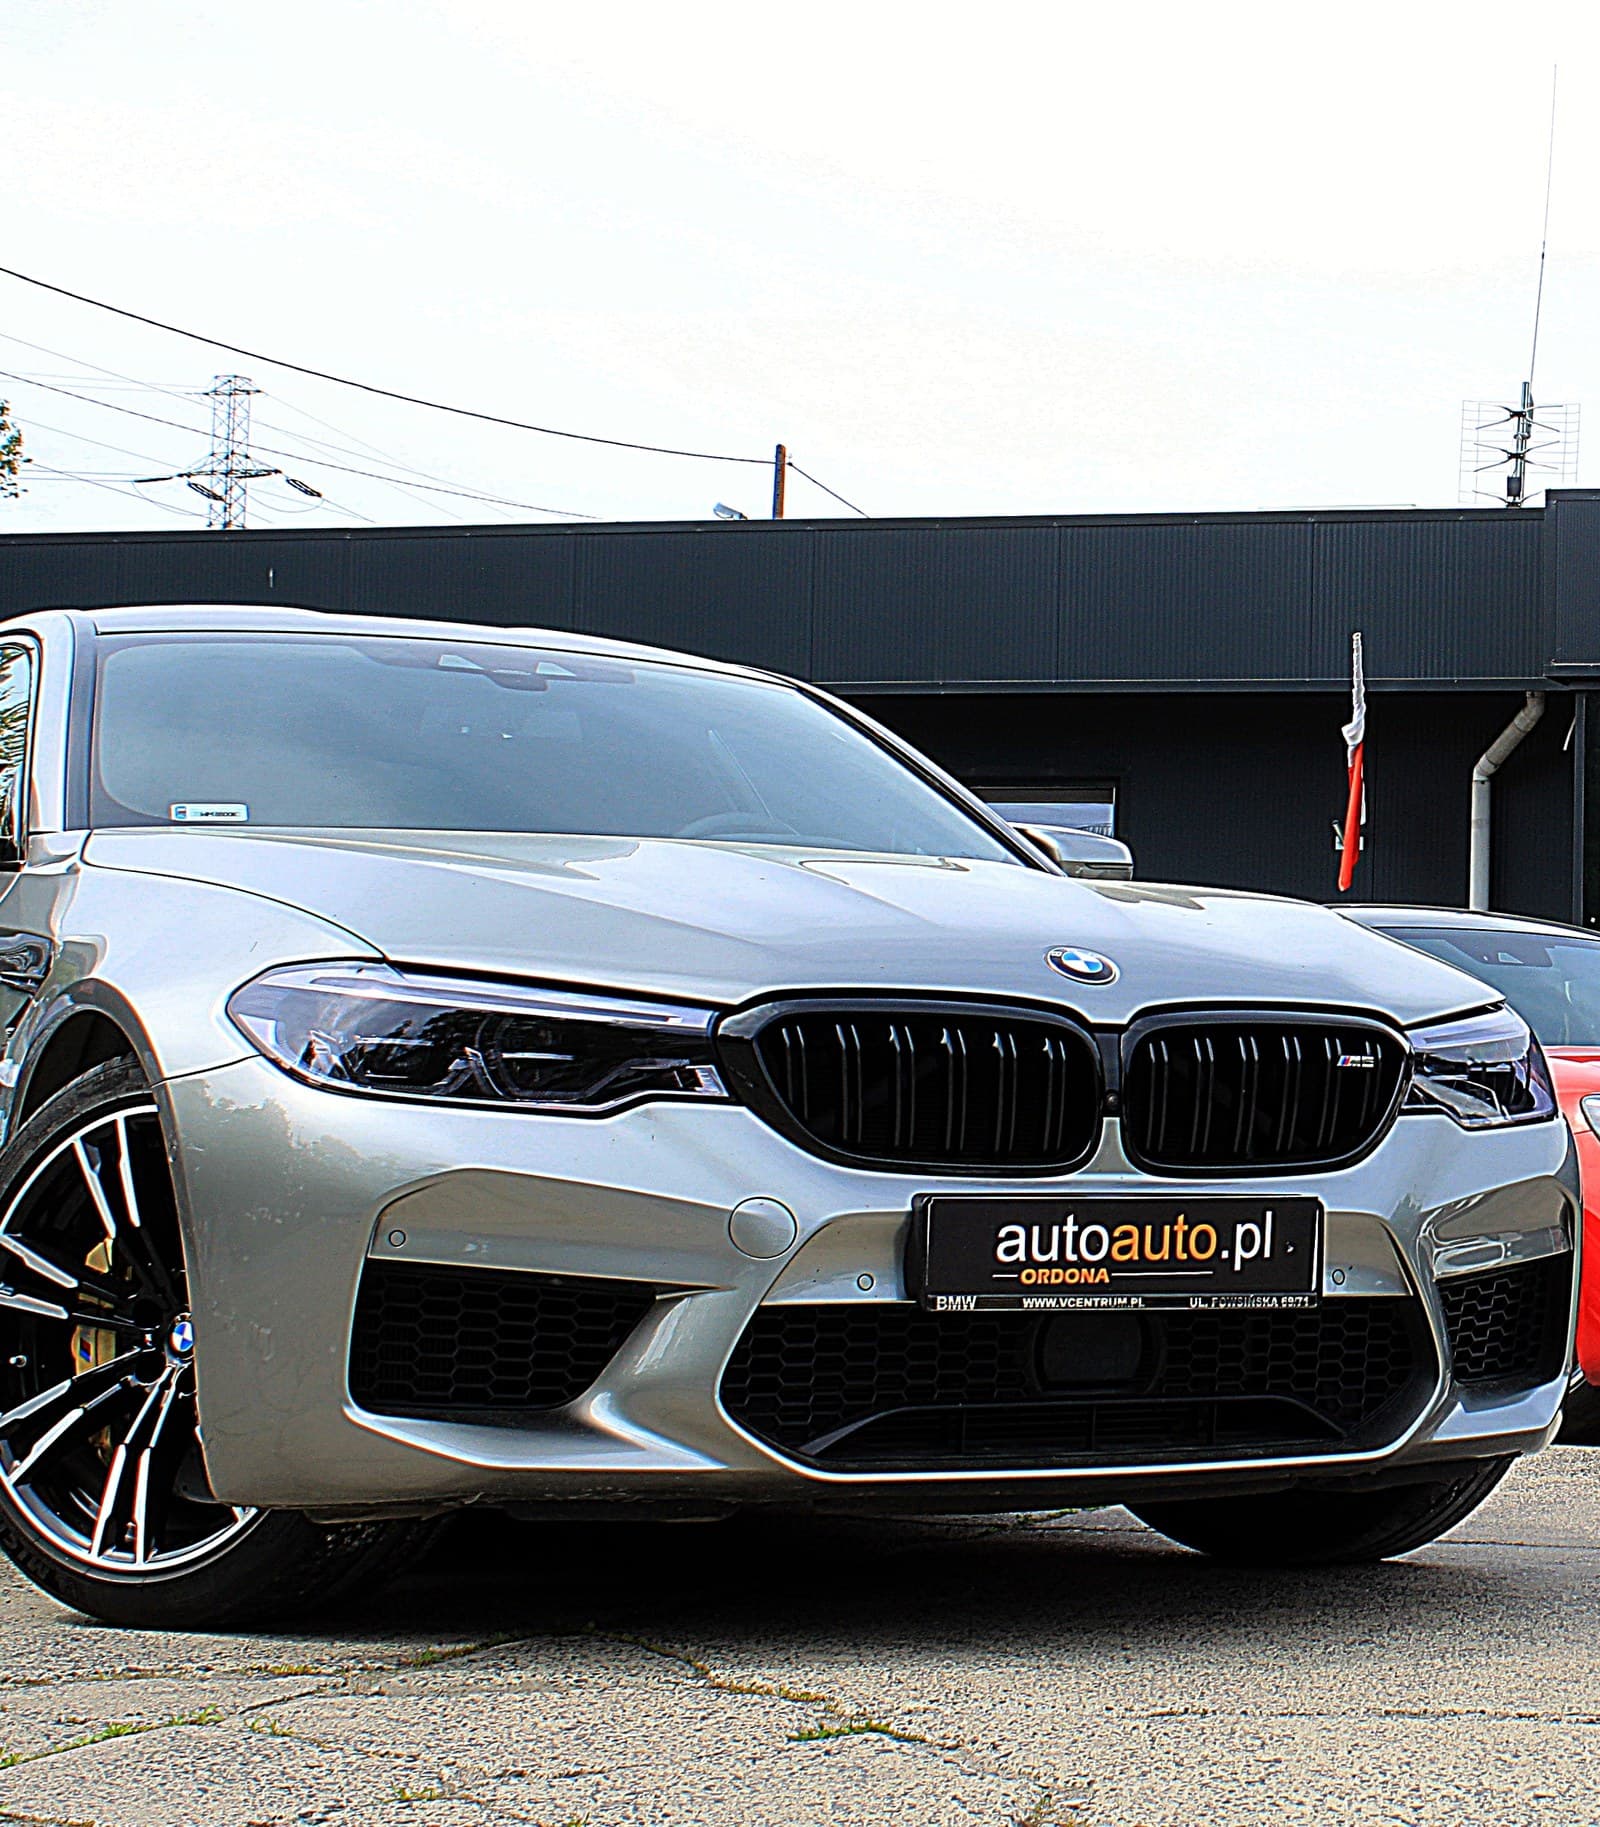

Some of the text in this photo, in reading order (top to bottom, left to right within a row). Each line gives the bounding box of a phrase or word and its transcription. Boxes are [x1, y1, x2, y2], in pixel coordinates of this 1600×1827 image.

[996, 1210, 1273, 1272] autoauto.pl
[1019, 1267, 1110, 1285] ORDONA
[936, 1295, 977, 1311] BMW
[1022, 1297, 1146, 1308] WWW.VCENTRUM.PL
